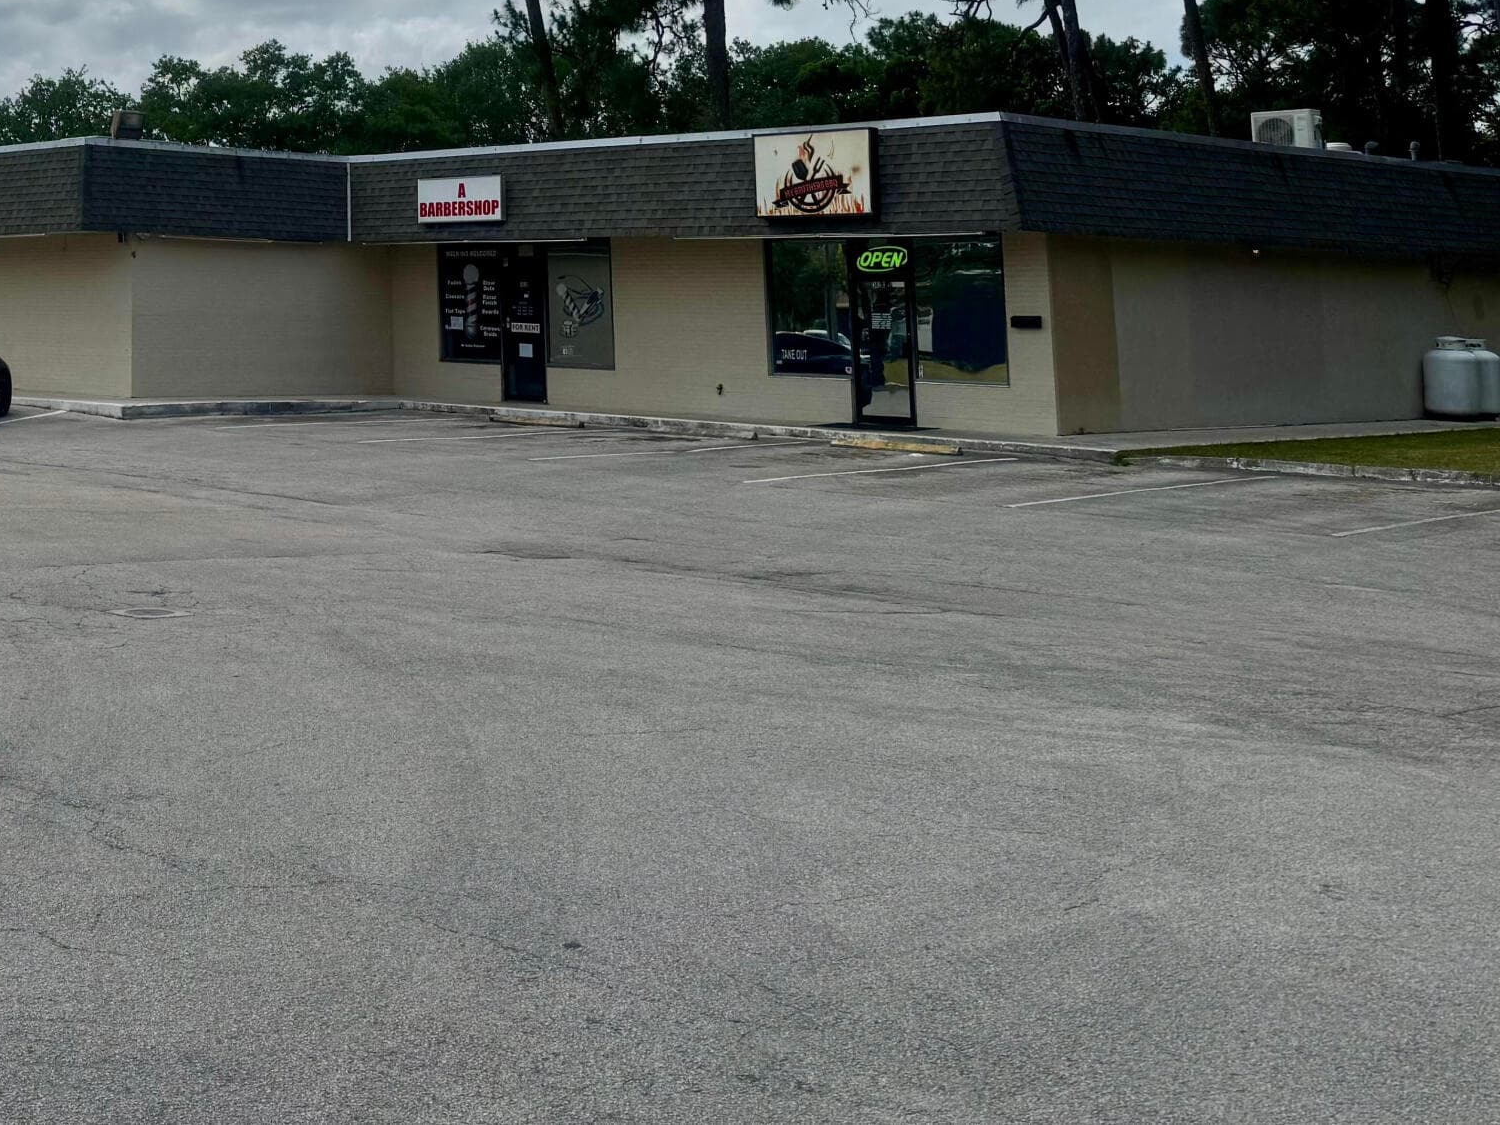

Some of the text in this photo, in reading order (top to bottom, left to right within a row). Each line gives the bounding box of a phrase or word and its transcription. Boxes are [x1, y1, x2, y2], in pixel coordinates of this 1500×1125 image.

[458, 183, 466, 198] A
[419, 200, 499, 218] BARBERSHOP
[860, 251, 903, 267] OPEN
[524, 324, 539, 332] RENT
[781, 349, 807, 362] TAKE OUT
